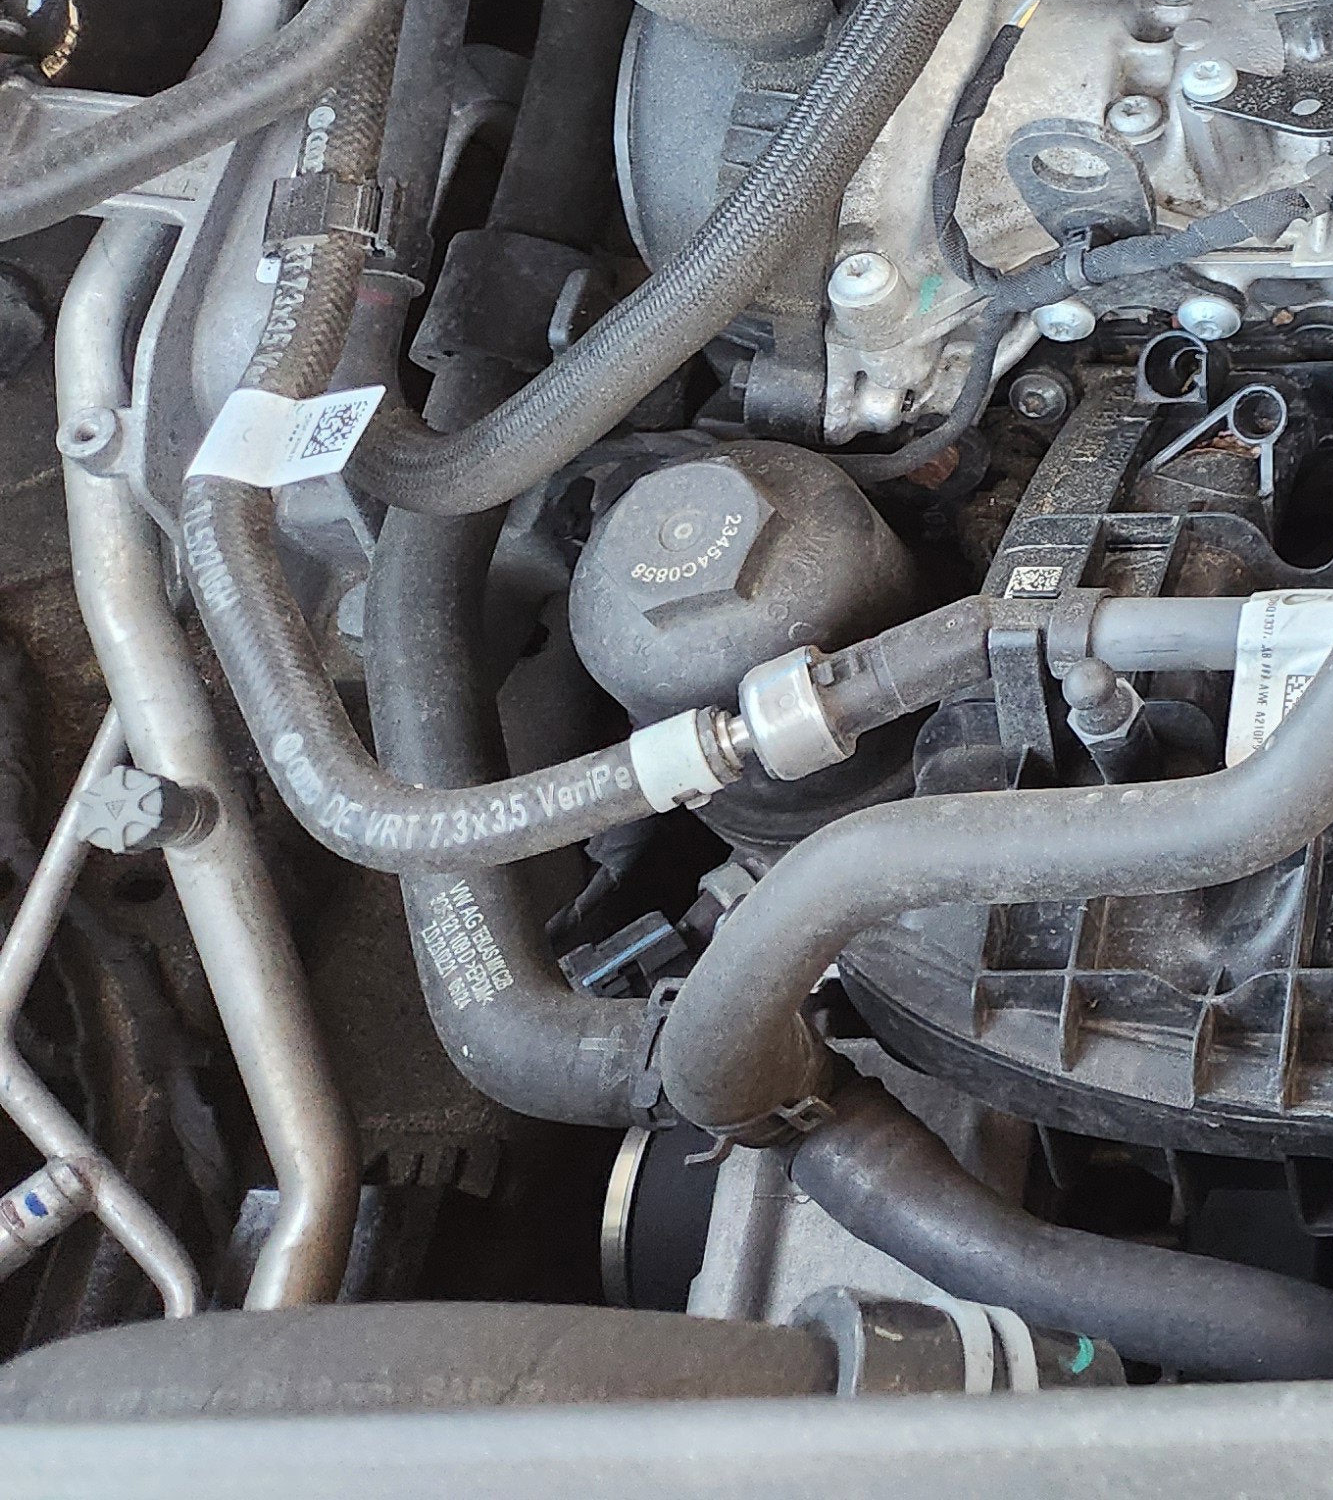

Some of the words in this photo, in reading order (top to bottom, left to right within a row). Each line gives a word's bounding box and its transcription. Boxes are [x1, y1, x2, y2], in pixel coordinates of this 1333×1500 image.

[631, 514, 741, 582] 23454C0858
[365, 812, 420, 848] VRT
[450, 880, 474, 906] VW
[459, 906, 483, 929] AG
[441, 915, 460, 936] 121
[457, 949, 475, 963] D
[472, 926, 498, 960] TEKLAS
